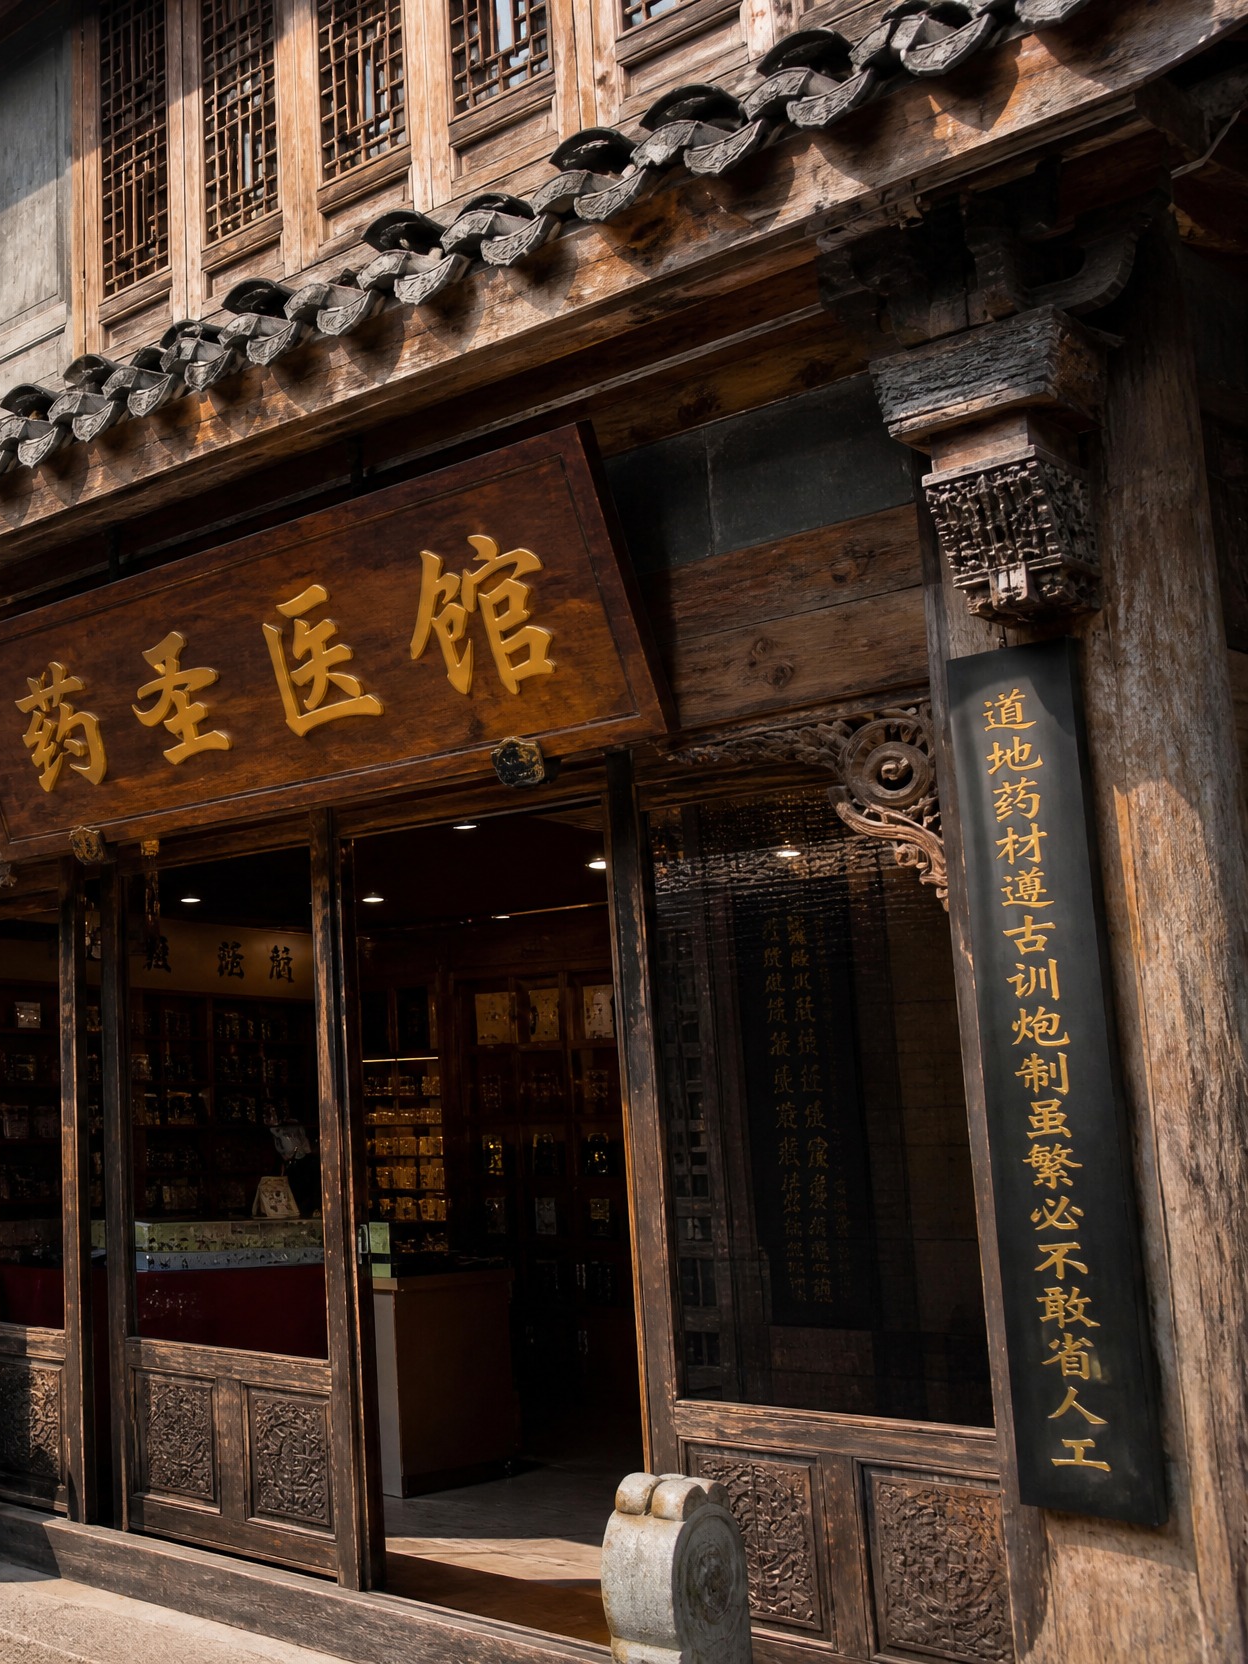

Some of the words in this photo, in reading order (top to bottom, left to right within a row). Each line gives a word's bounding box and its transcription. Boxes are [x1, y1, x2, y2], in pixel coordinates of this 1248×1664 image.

[15, 534, 556, 792] 药圣医馆
[982, 688, 1111, 1472] 道地药材遵古训炮制虽繁必不敢省人工
